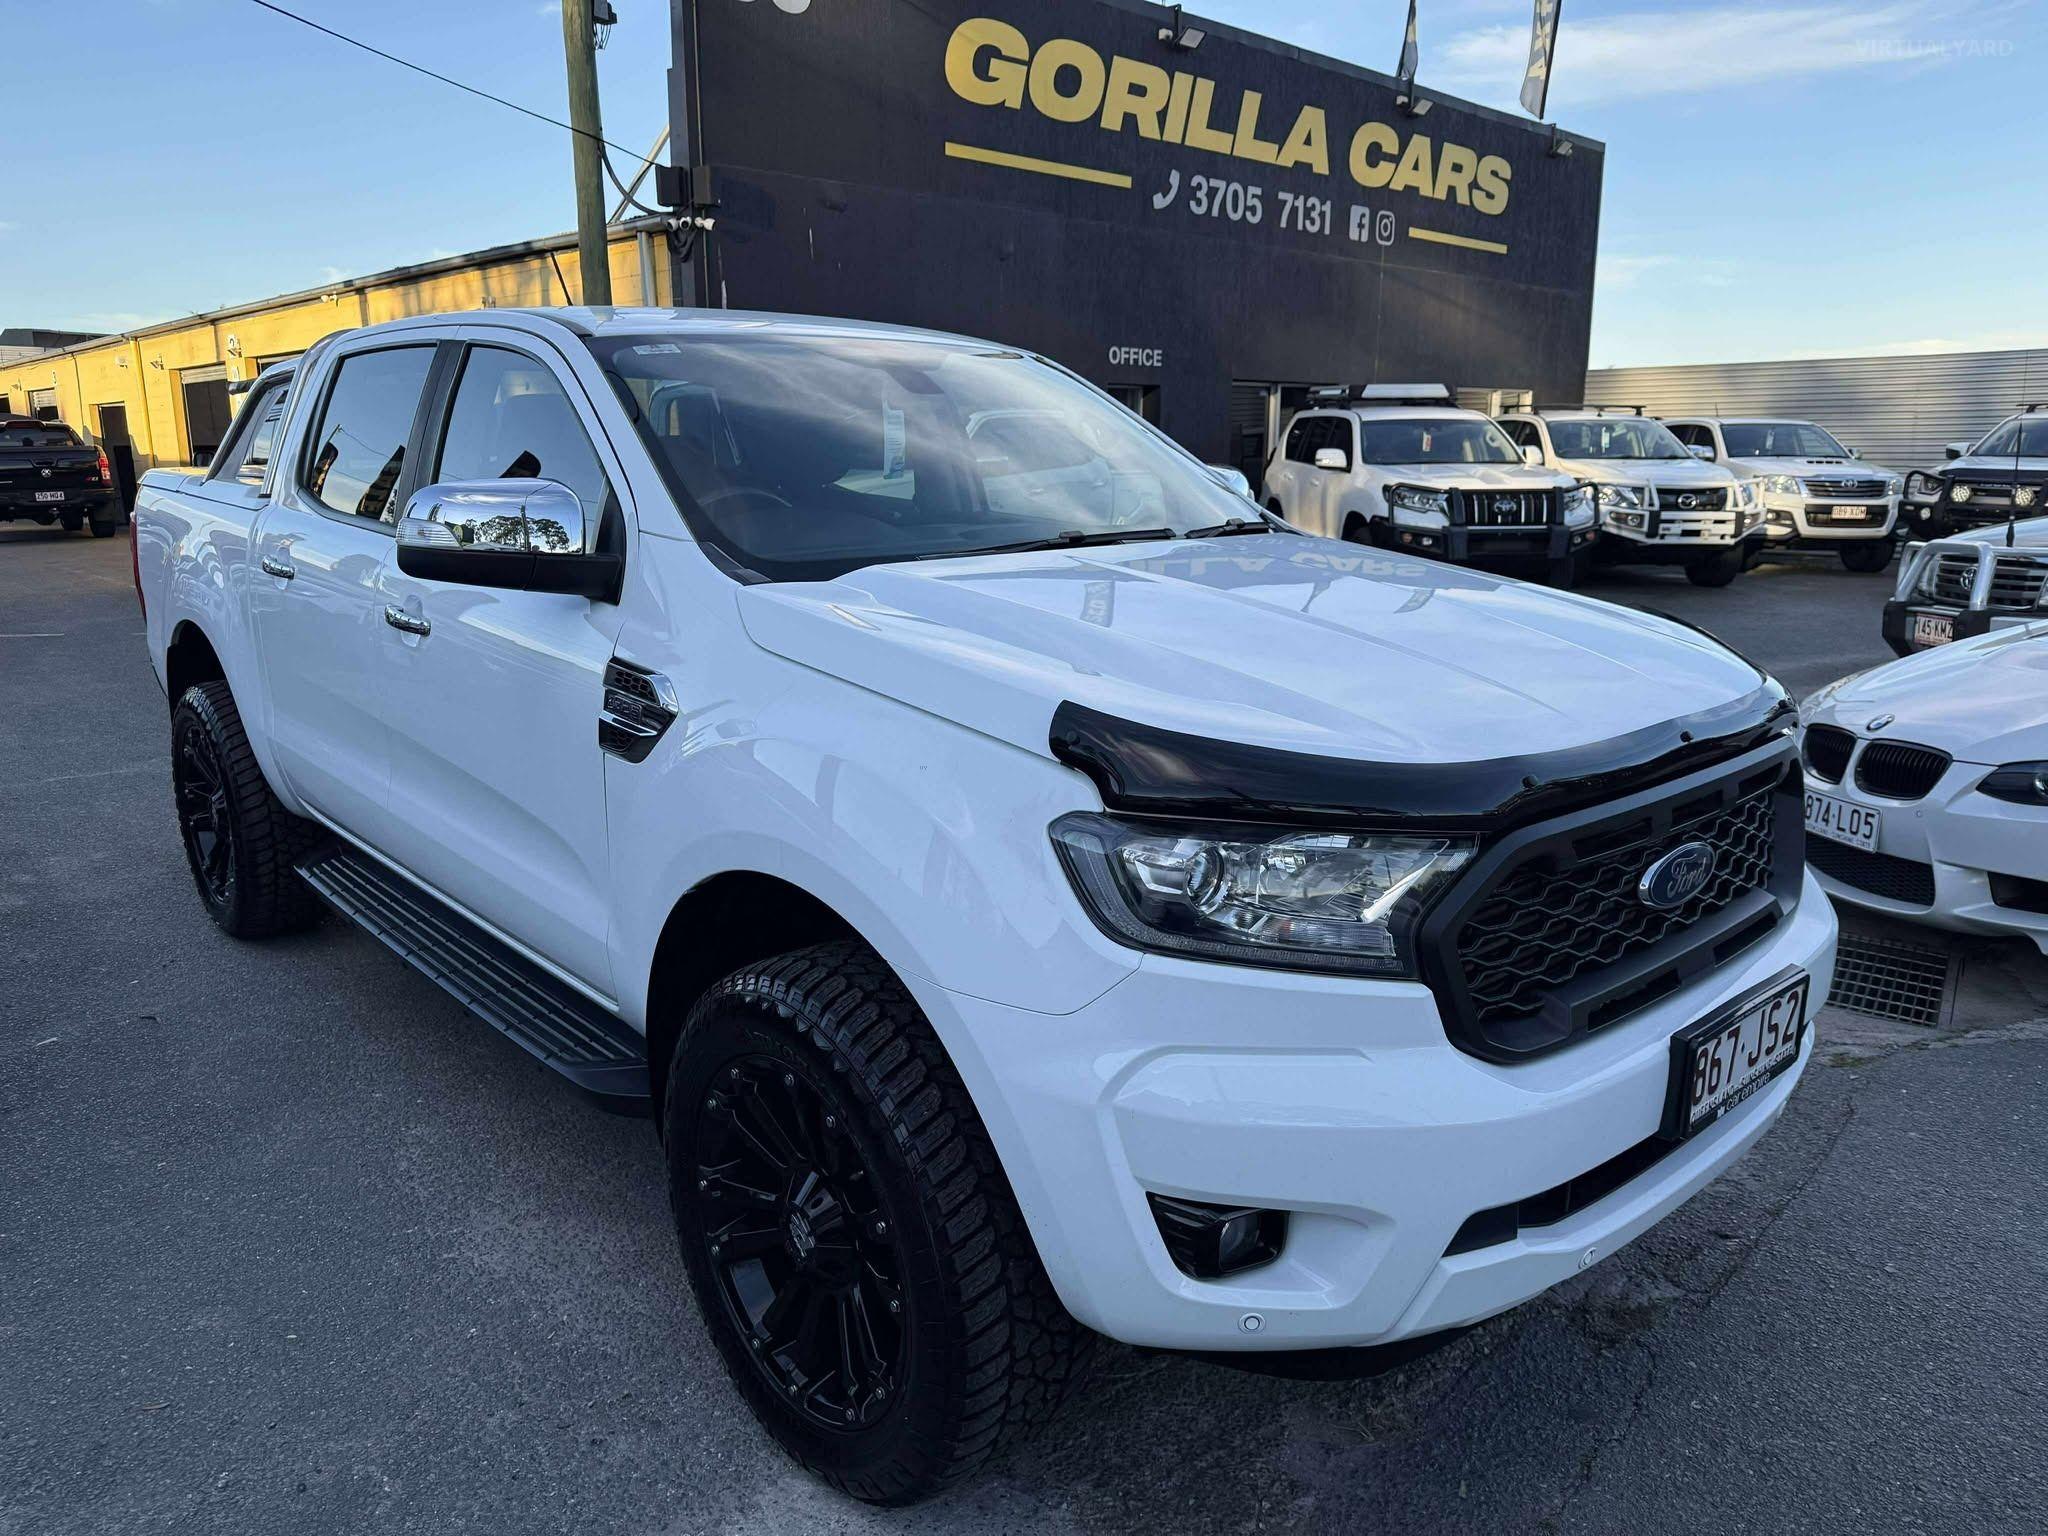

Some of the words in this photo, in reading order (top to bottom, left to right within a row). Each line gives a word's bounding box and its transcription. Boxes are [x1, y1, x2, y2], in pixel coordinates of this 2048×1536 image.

[944, 17, 1330, 175] GORILLA
[1348, 121, 1513, 216] CARS
[1188, 174, 1264, 226] 3705
[1277, 191, 1333, 237] 7131
[1108, 345, 1163, 367] OFFICE
[1667, 853, 1708, 899] Ford
